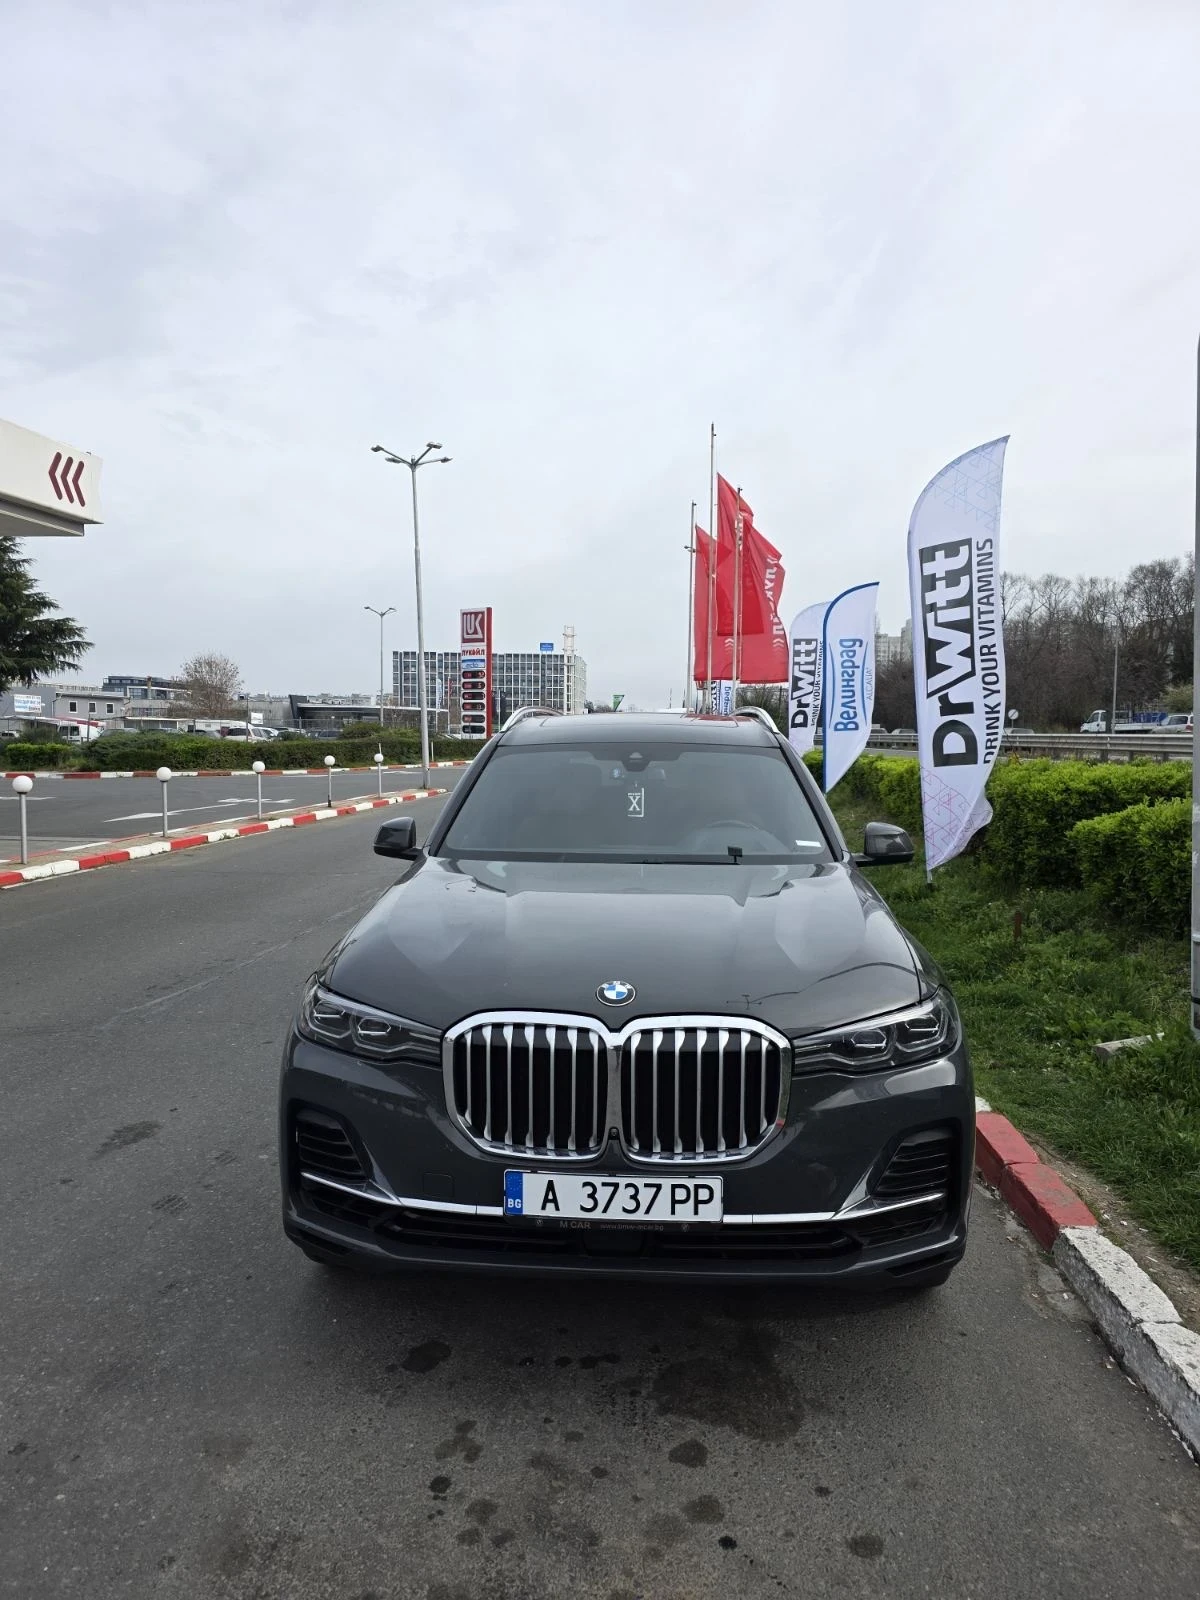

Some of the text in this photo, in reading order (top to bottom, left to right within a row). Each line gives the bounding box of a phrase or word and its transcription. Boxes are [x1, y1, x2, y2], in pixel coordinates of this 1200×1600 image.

[975, 538, 996, 641] VITAMINS
[791, 638, 818, 729] DrWitt
[833, 638, 864, 732] Велинград
[918, 537, 978, 768] DrWitt
[979, 642, 1000, 699] YOUR
[507, 1199, 522, 1209] BG
[540, 1179, 715, 1216] A 3737 PP
[570, 1221, 592, 1230] CAR
